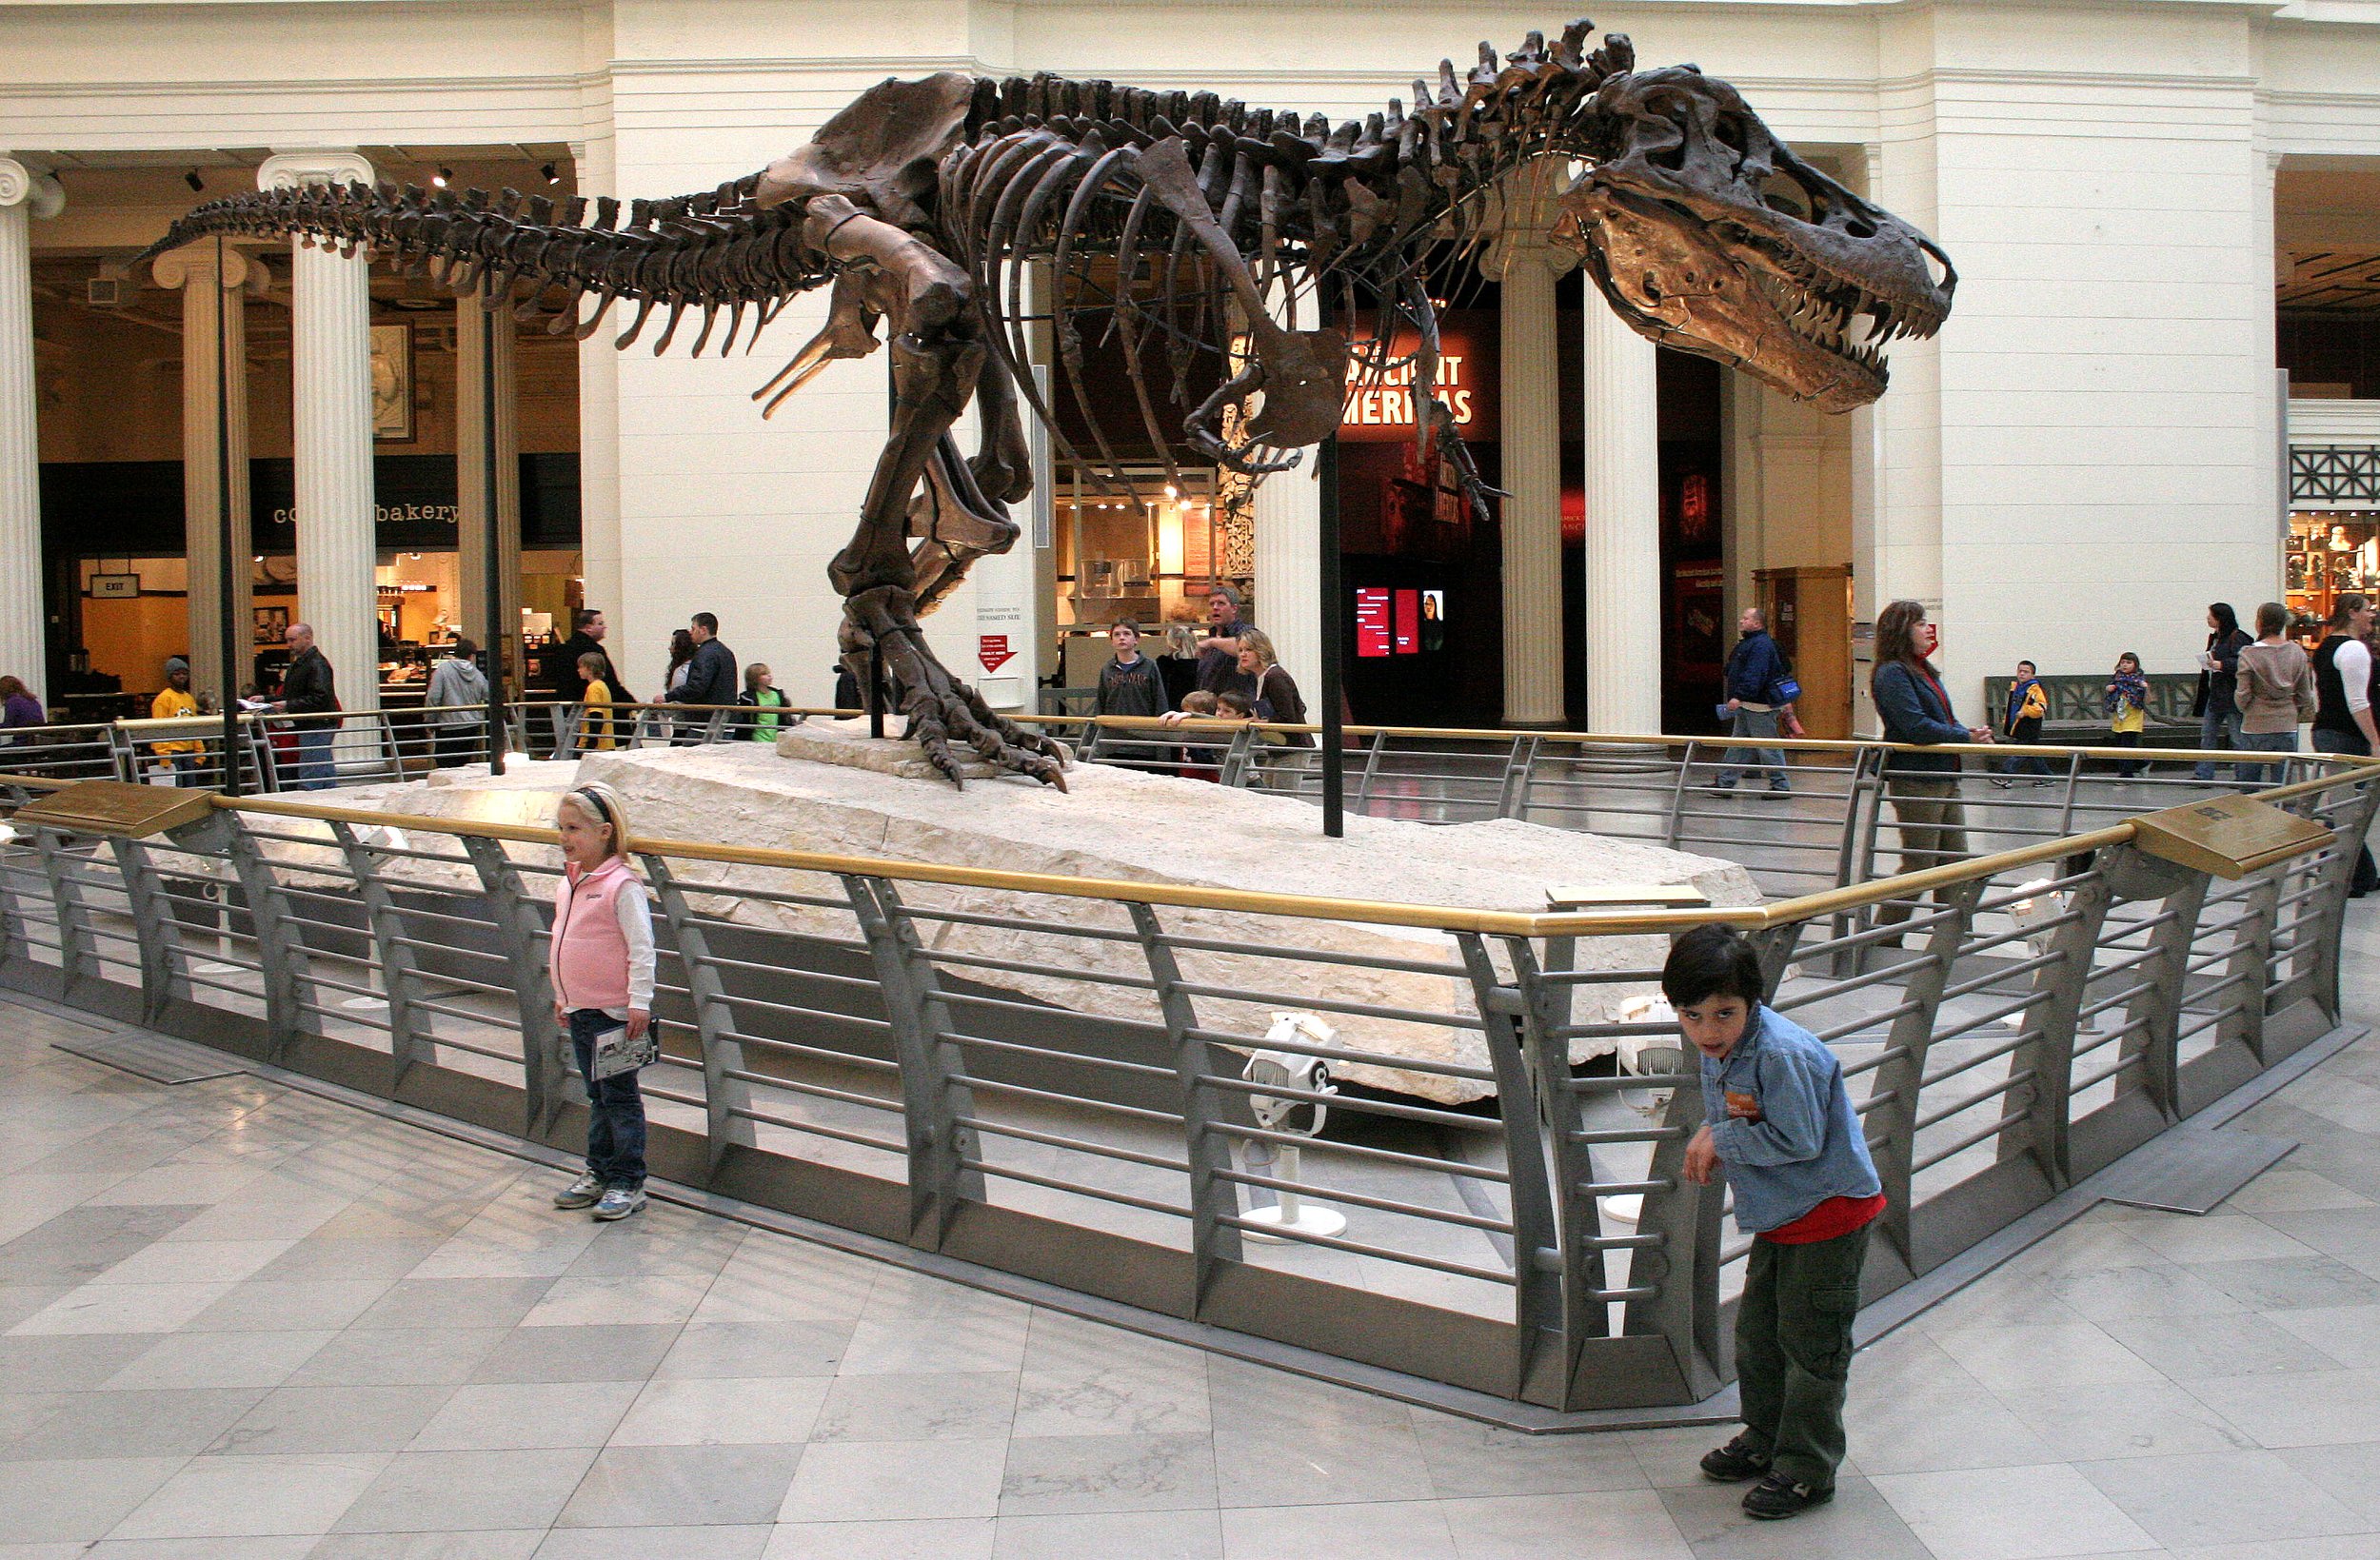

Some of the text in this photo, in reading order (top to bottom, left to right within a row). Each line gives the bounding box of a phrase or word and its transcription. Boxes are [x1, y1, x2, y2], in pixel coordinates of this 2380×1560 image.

[1341, 389, 1472, 425] MERIAS
[374, 504, 460, 523] bakery
[106, 583, 124, 591] EXIT
